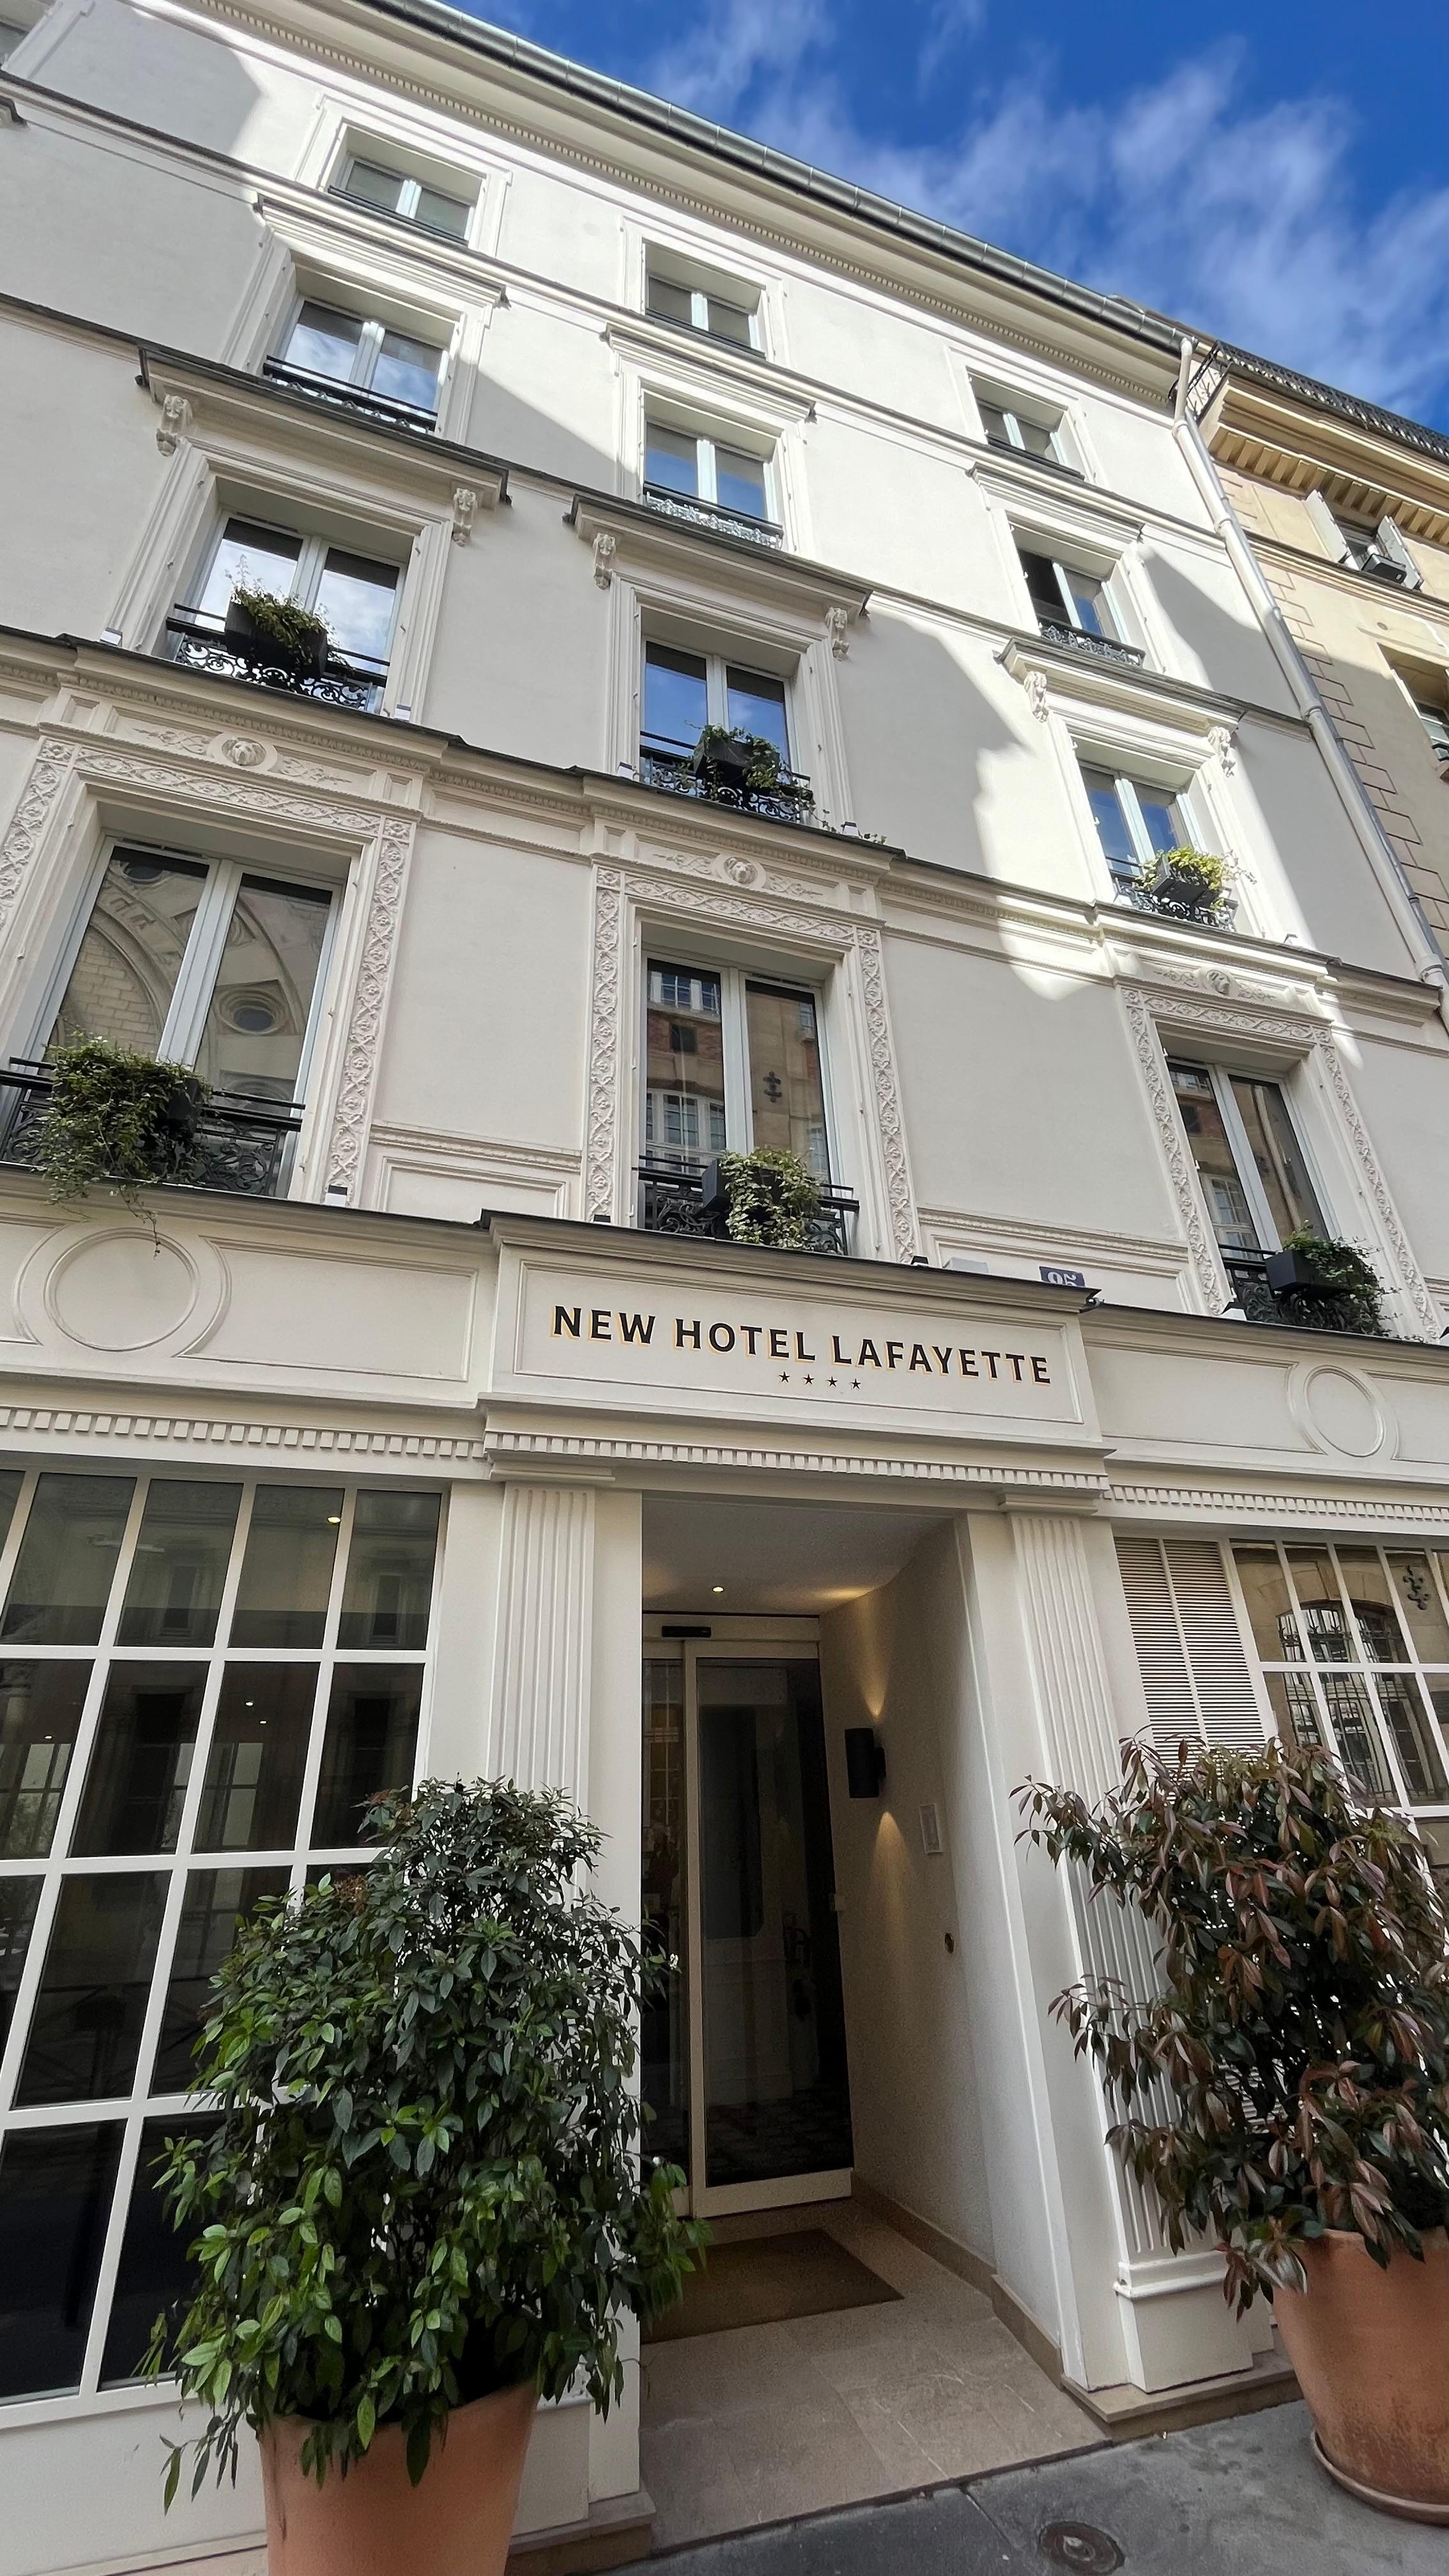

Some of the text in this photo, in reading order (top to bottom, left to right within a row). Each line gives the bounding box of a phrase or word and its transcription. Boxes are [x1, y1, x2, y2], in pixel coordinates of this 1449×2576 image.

[552, 1305, 1050, 1384] NEW HOTEL LAFAYETTE
